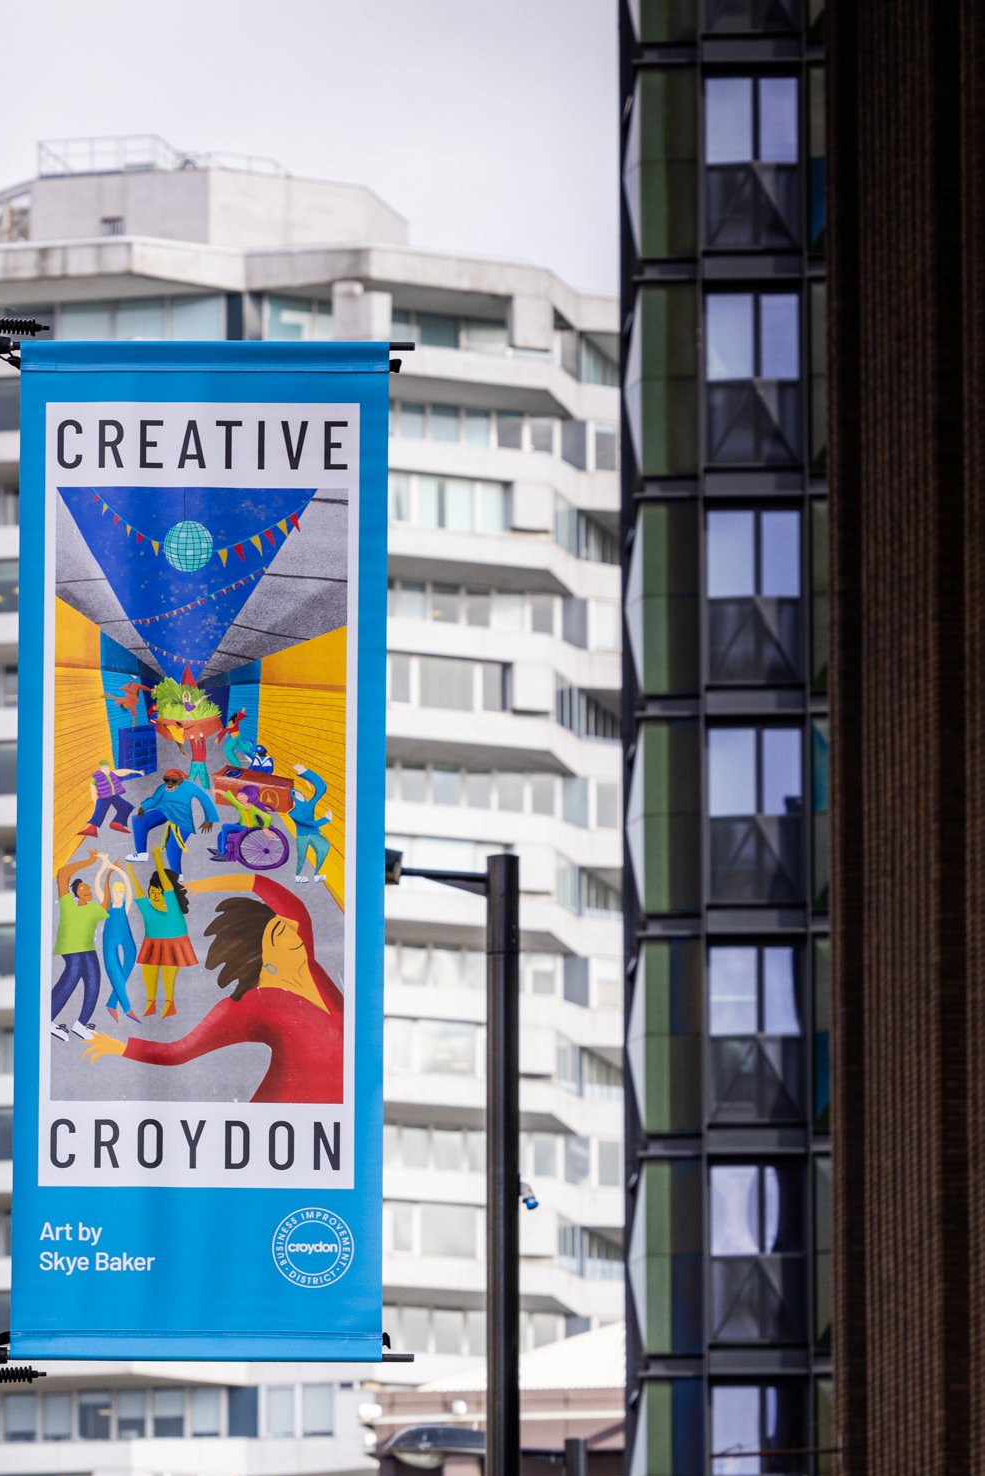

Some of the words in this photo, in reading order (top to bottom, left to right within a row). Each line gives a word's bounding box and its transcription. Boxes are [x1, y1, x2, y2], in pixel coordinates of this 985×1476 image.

[56, 418, 350, 471] CREATIVE
[49, 1117, 342, 1172] CROYDON
[39, 1222, 73, 1242] Art
[78, 1221, 103, 1246] by
[275, 1217, 299, 1267] BUSINESS
[300, 1210, 351, 1268] IMPROVEMENT
[287, 1240, 338, 1255] croydon
[39, 1251, 90, 1276] Skye
[94, 1252, 156, 1272] Baker
[288, 1270, 337, 1286] DISTRICT
